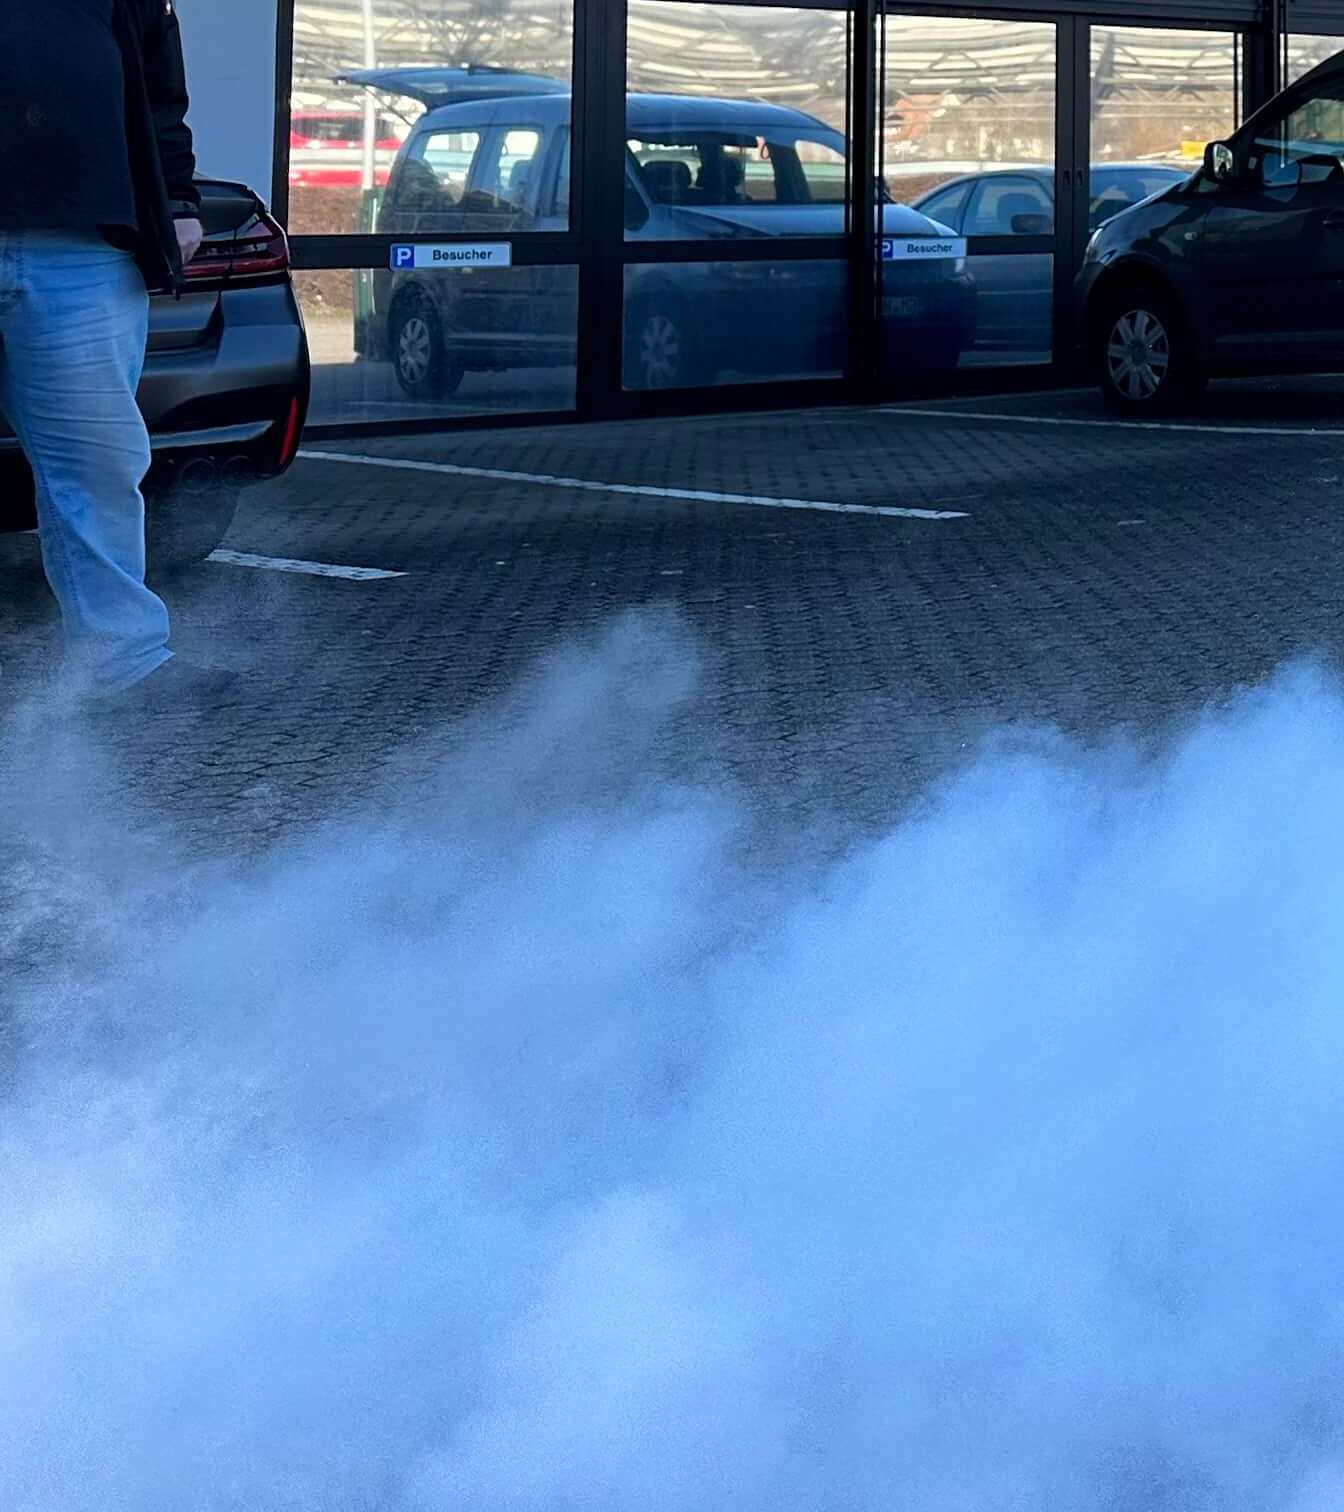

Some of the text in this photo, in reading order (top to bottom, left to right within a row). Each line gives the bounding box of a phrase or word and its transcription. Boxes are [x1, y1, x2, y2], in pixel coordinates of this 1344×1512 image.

[906, 243, 953, 254] Besucher
[396, 247, 493, 266] P Besucher
